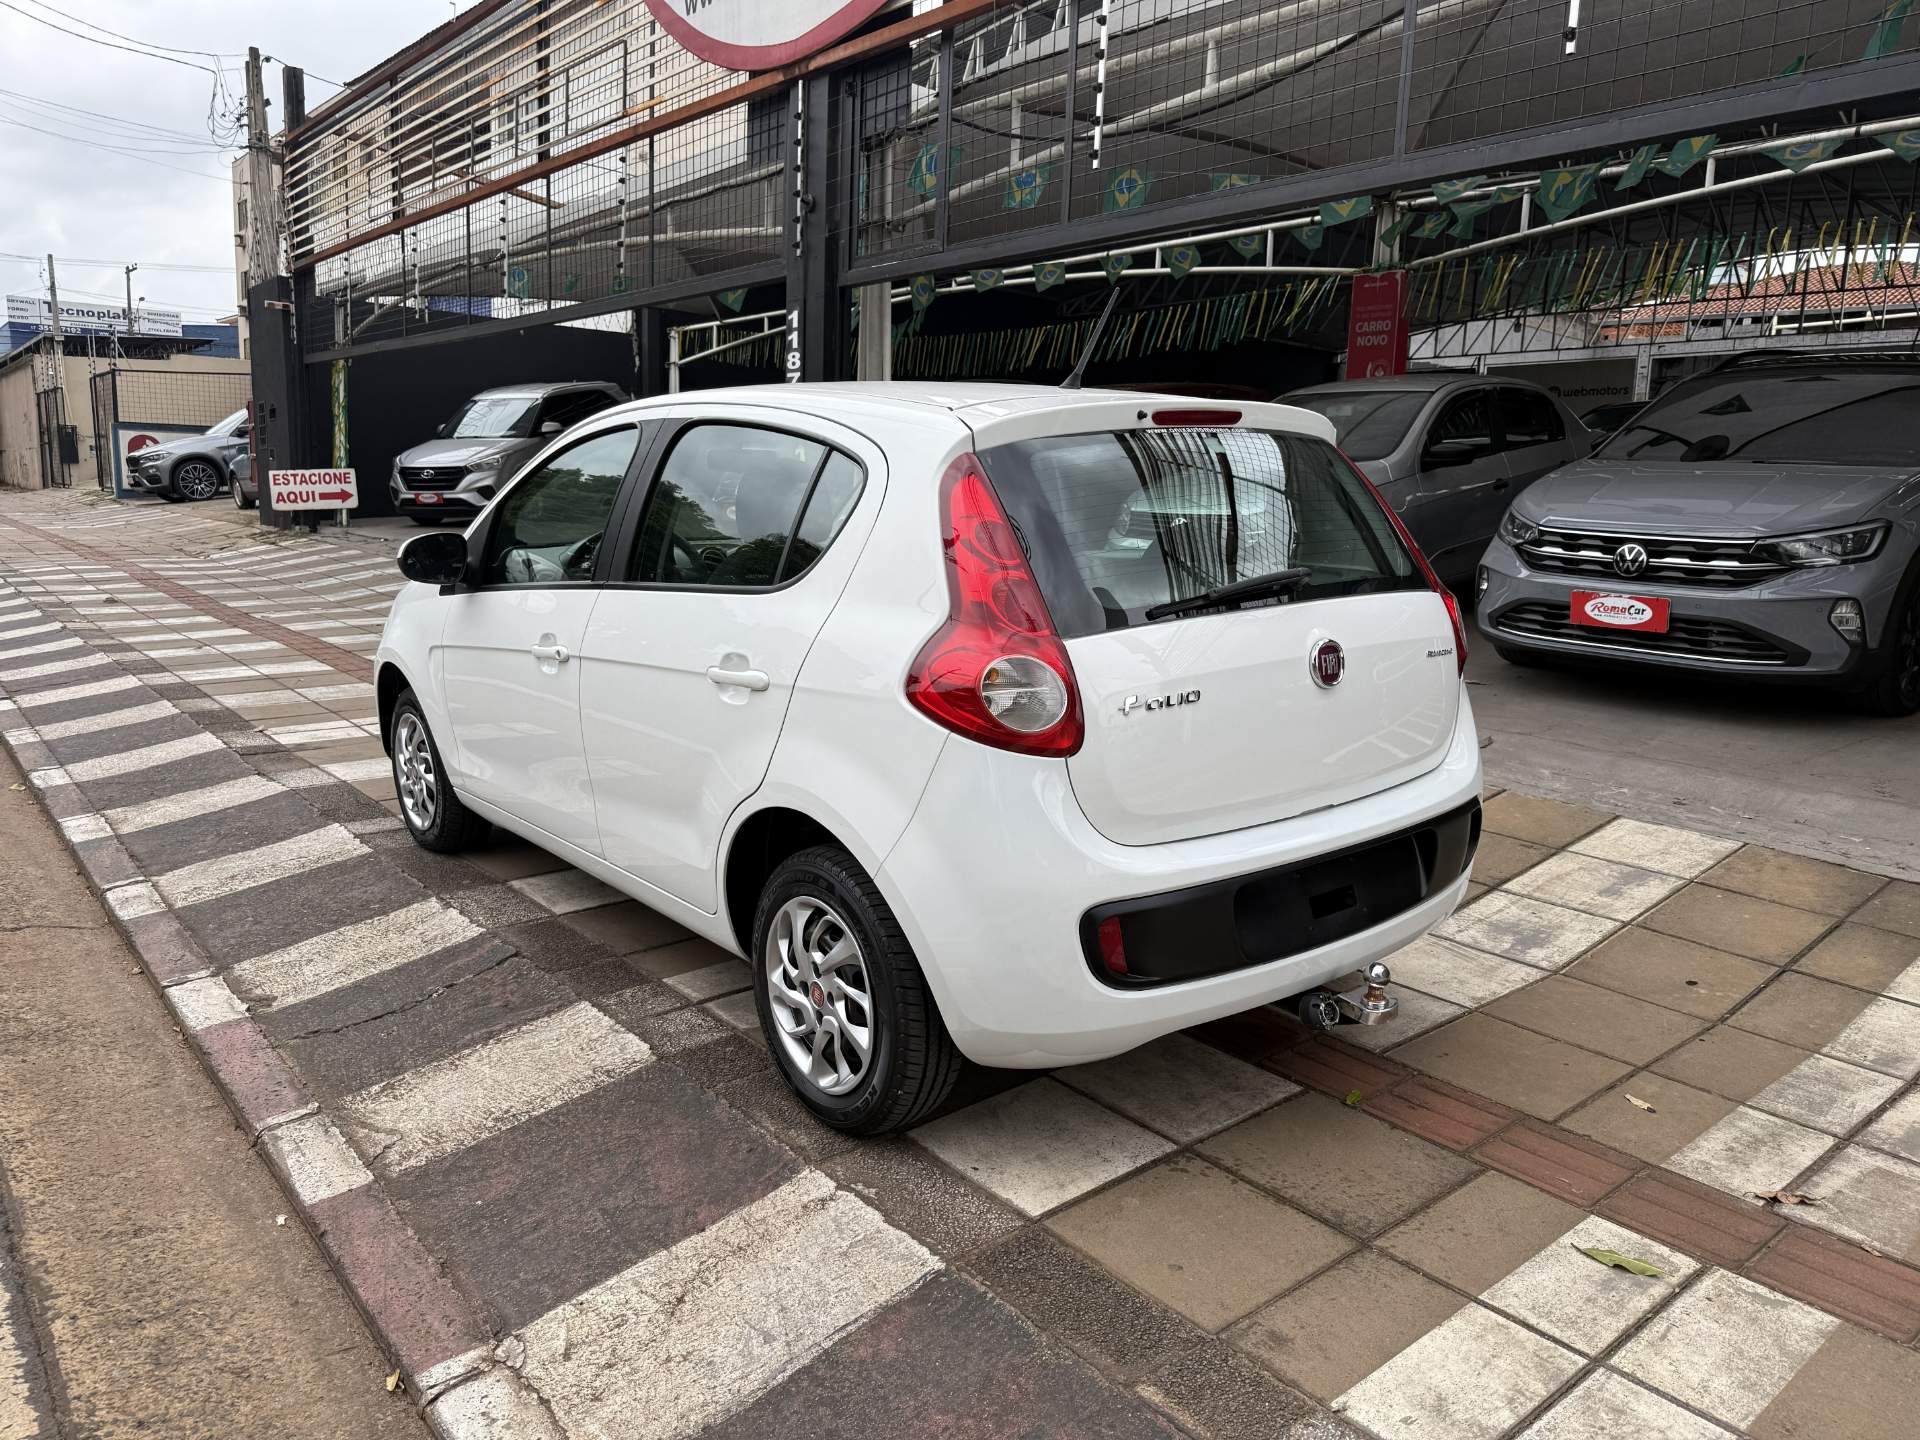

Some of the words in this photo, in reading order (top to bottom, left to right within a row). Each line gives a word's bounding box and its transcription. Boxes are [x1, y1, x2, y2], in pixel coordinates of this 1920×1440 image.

[1355, 320, 1392, 333] CARRO
[786, 310, 801, 384] 1187
[1356, 335, 1388, 347] NOVO
[1562, 385, 1630, 397] webmotors
[272, 472, 352, 486] ESTACIONE
[275, 490, 316, 504] AQUI
[1591, 602, 1647, 616] RomaCar
[1321, 653, 1339, 676] FIAT
